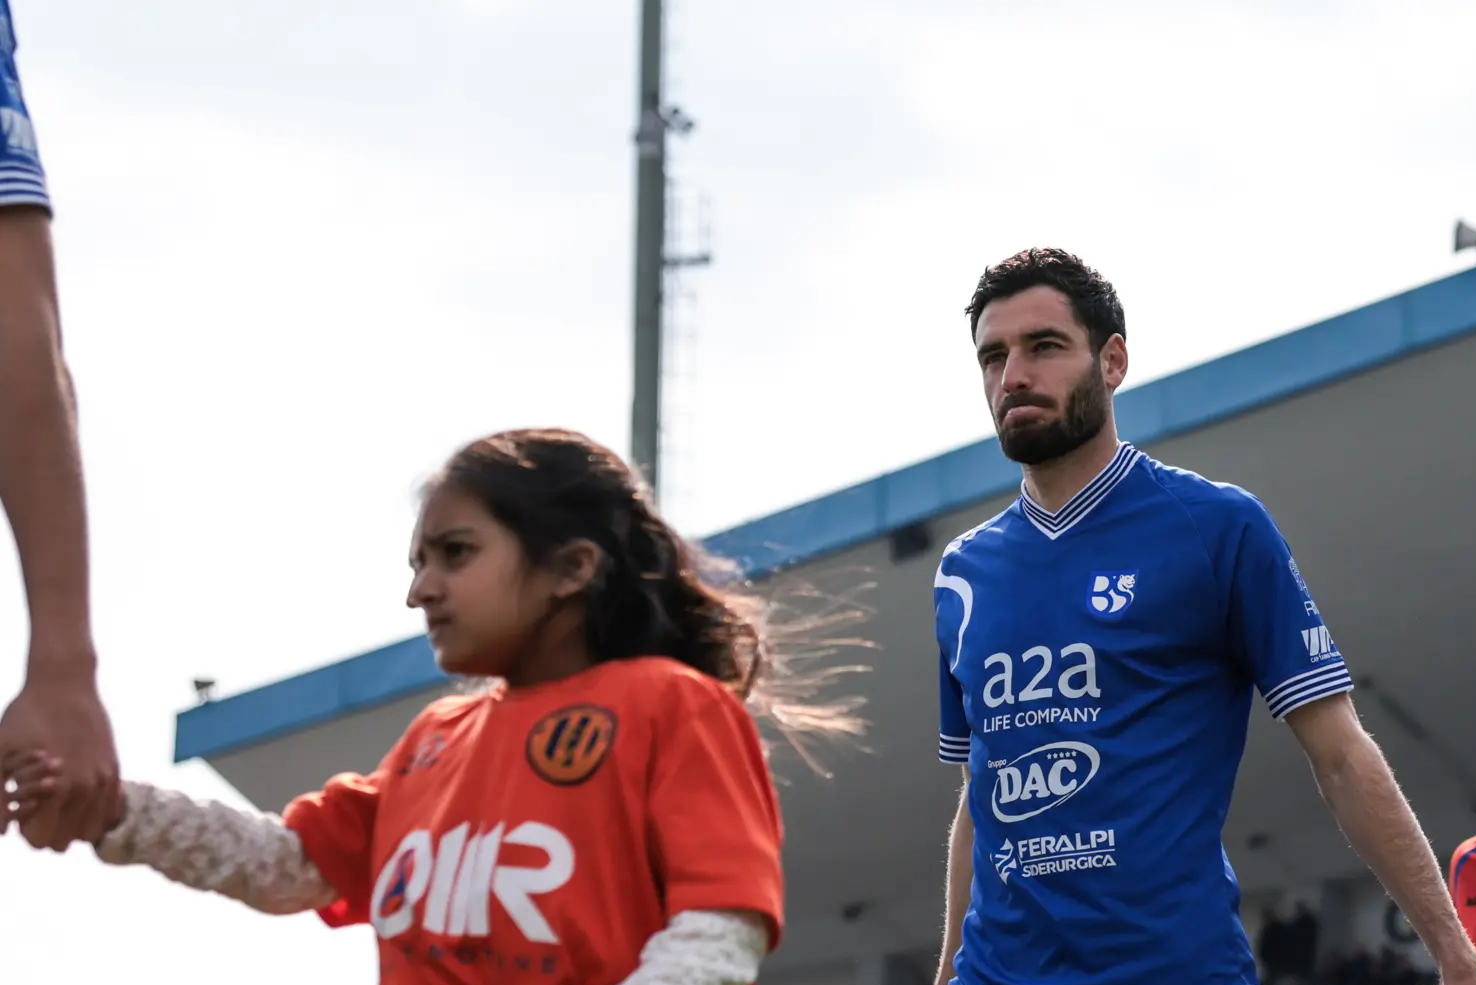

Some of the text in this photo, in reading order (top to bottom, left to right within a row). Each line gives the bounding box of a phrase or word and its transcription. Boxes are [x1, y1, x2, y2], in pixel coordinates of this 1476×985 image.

[982, 642, 1101, 708] a2a
[983, 707, 1102, 733] LIFE COMPANY
[987, 758, 1007, 769] Gruppo
[997, 758, 1078, 804] DAC
[1017, 829, 1116, 859] FERALPI
